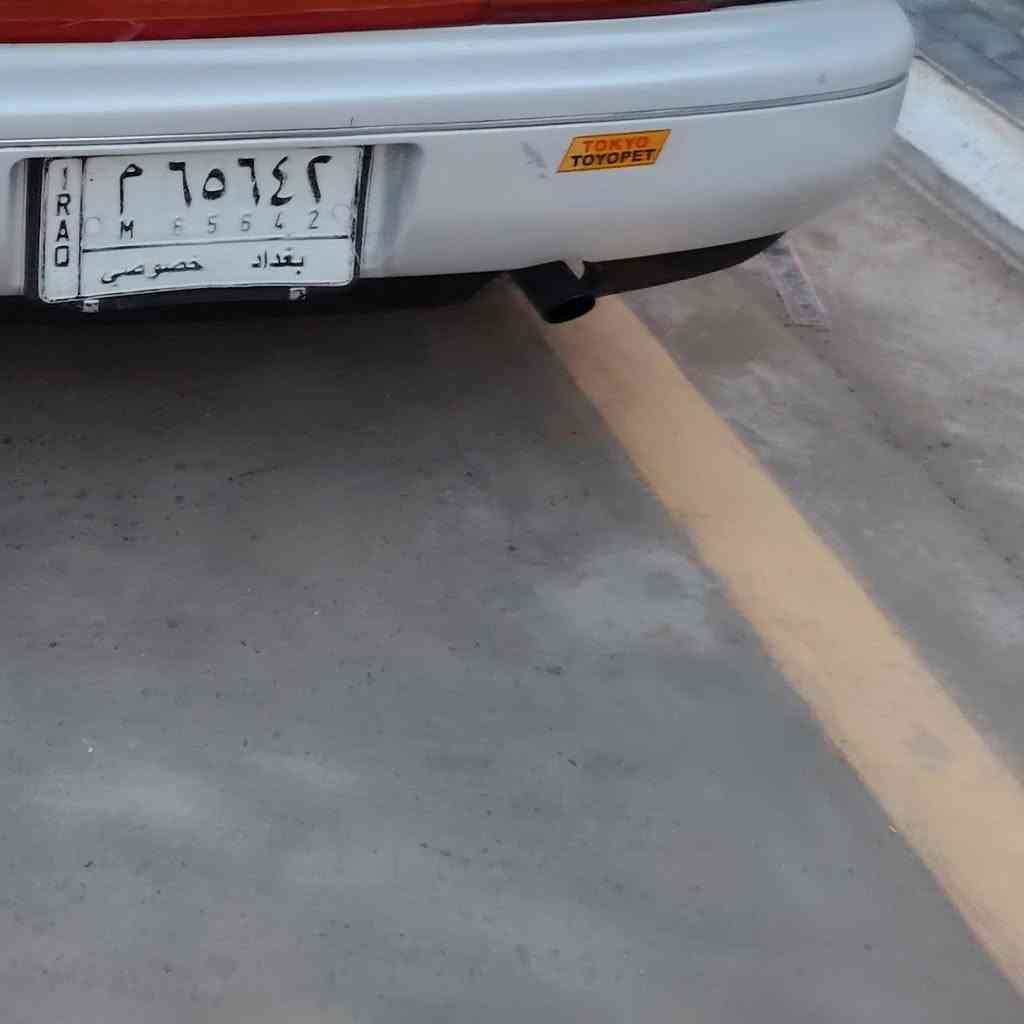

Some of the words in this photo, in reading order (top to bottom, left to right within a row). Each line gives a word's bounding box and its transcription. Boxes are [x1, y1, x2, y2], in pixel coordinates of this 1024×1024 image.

[583, 136, 649, 153] TOKYO
[571, 148, 657, 167] TOYOPET
[54, 167, 72, 268] IRAQ
[251, 247, 305, 275] بغداد
